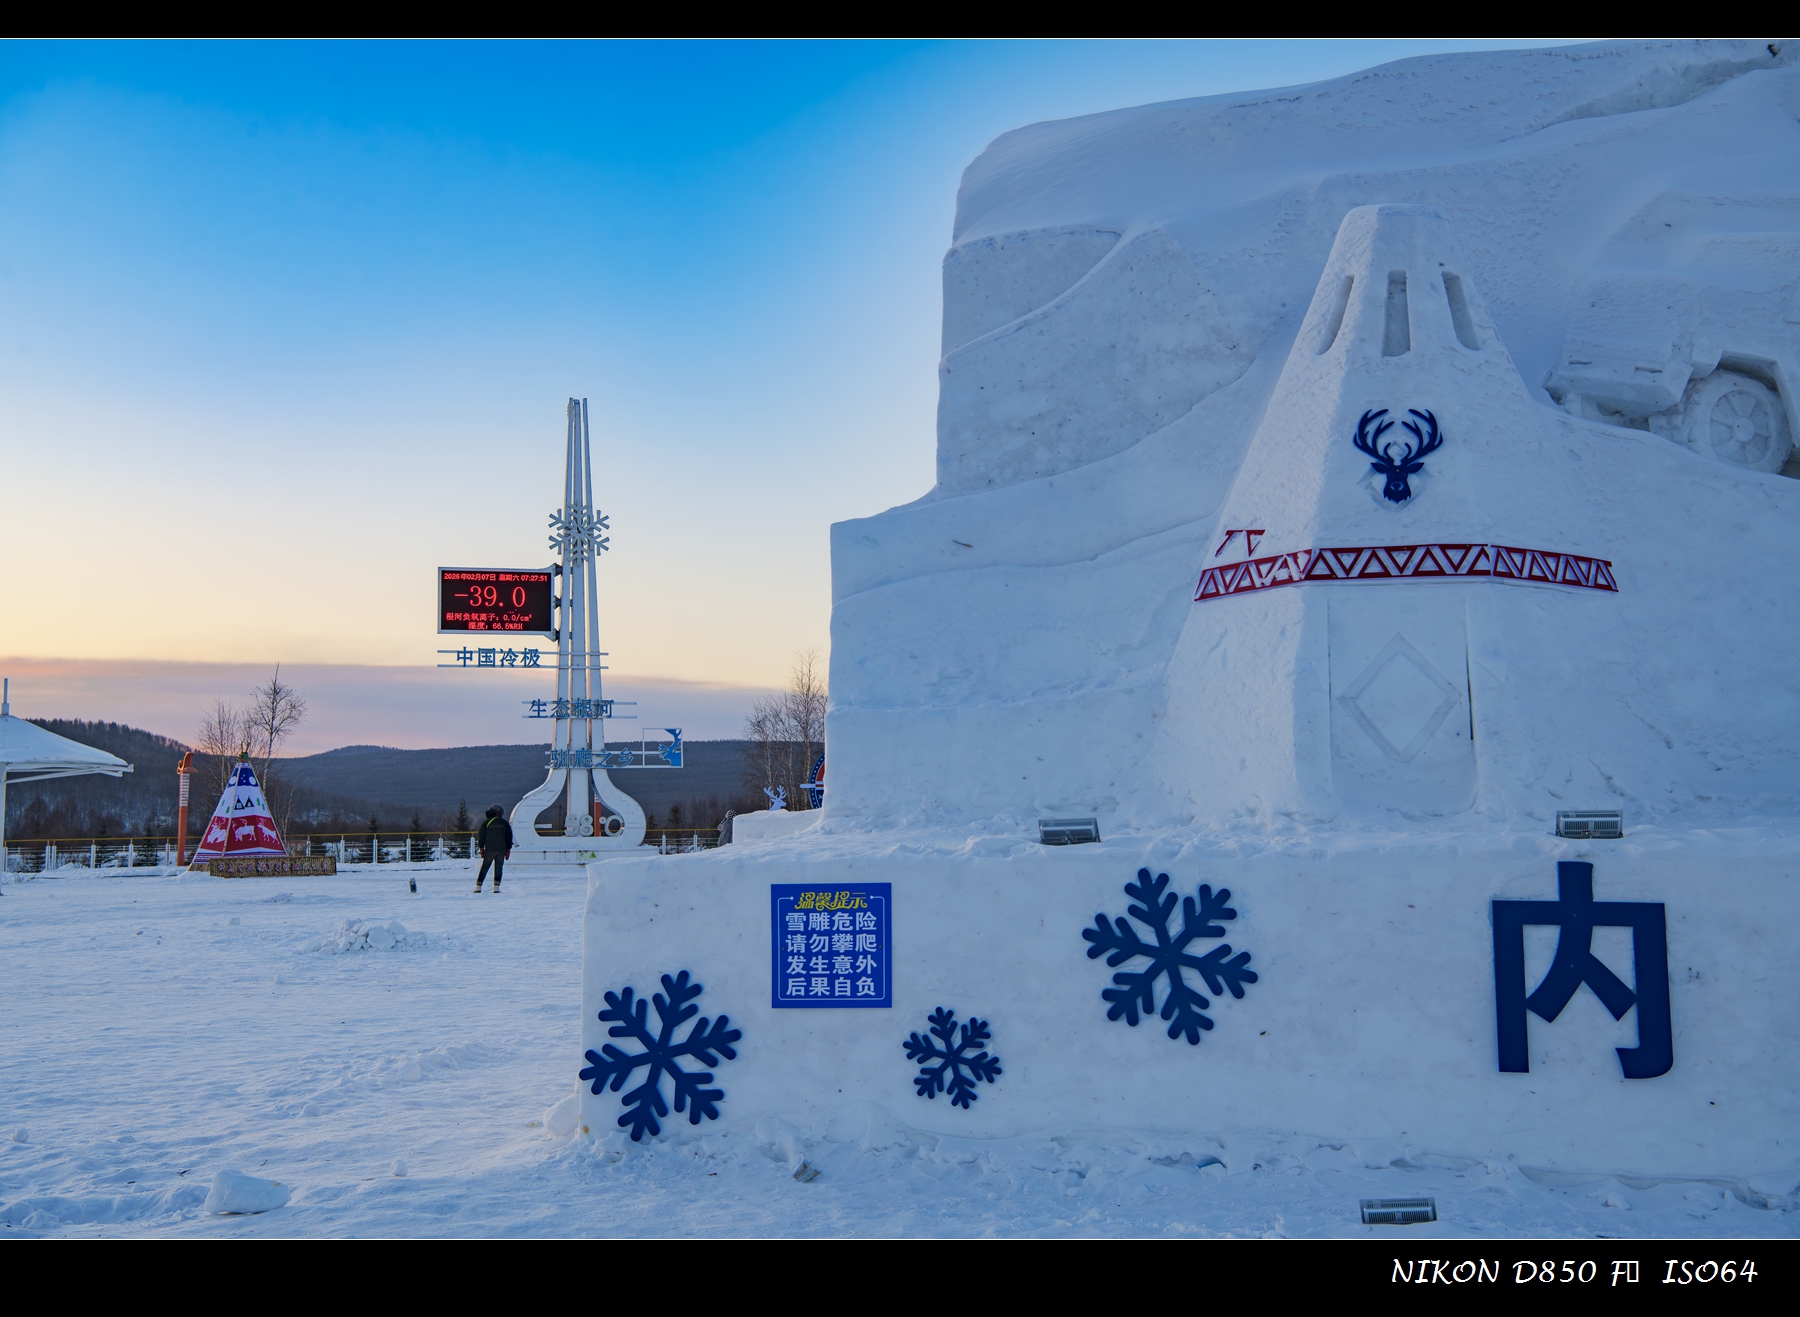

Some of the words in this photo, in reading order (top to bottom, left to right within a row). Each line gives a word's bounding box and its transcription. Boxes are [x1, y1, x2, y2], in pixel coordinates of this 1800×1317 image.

[454, 586, 526, 607] -39.0
[456, 647, 541, 668] 中国冷极
[529, 698, 614, 719] 生态根河
[549, 747, 634, 769] 驯鹿之乡
[794, 891, 868, 911] 温馨提示
[785, 911, 877, 931] 雪雕危险
[785, 933, 877, 953] 请勿攀爬
[786, 955, 877, 975] 发生意外
[1492, 861, 1674, 1079] 内
[786, 977, 877, 997] 后果自负
